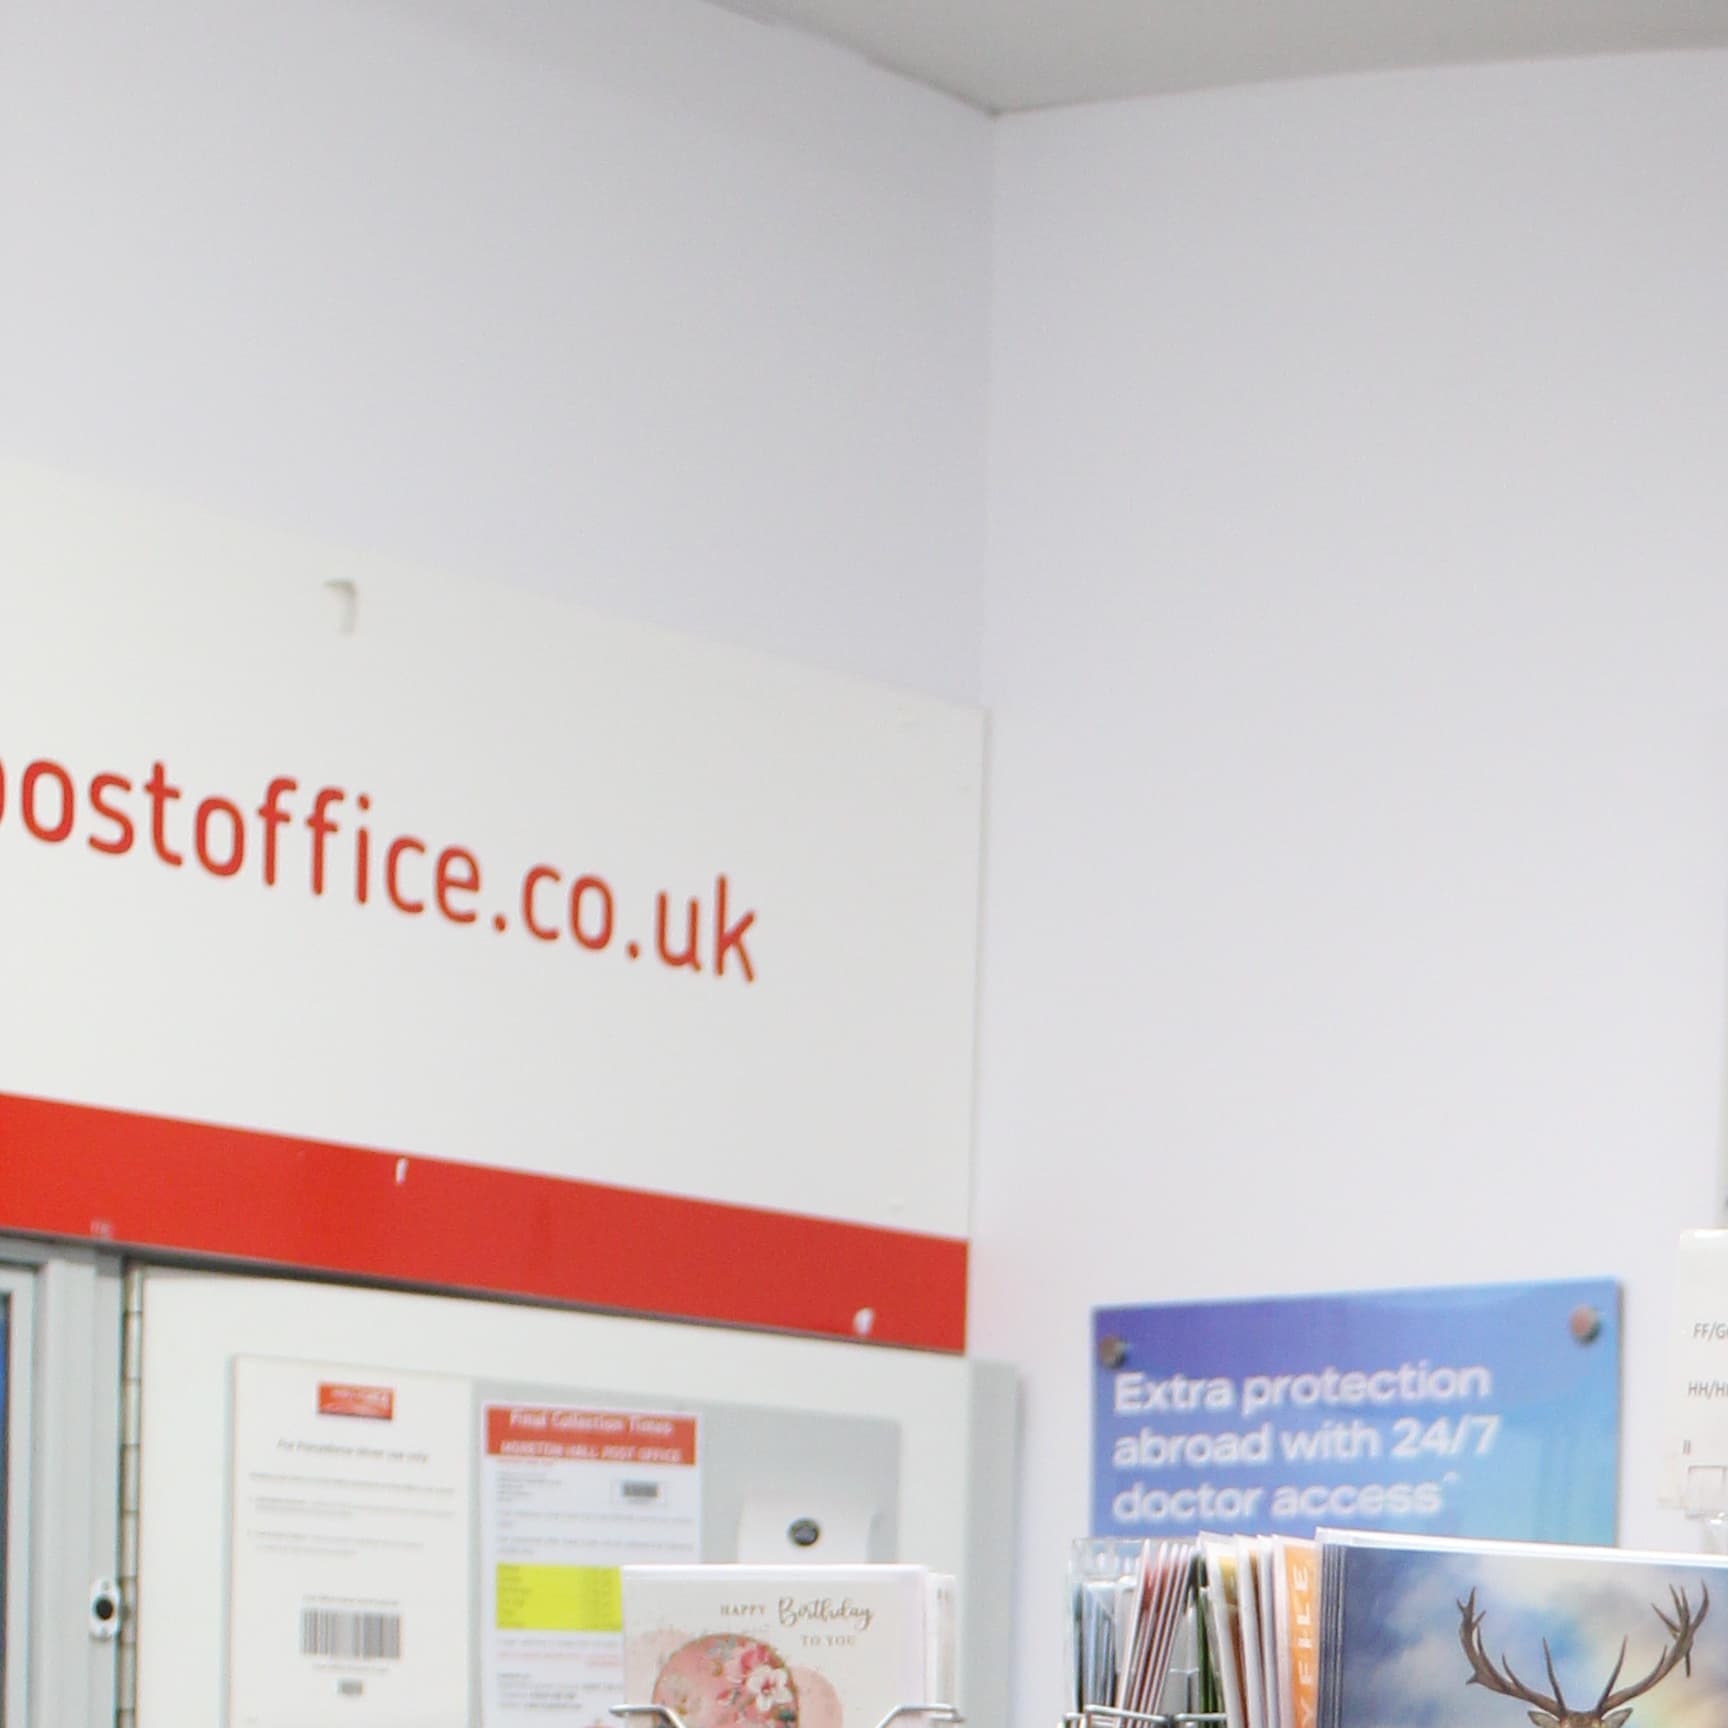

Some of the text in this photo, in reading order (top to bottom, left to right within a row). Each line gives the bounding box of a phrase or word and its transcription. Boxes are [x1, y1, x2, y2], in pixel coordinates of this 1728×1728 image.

[0, 757, 757, 983] ostoffice.co.uk
[1114, 1358, 1491, 1417] Extra protection
[1112, 1413, 1502, 1469] abroad with 24/7
[1114, 1484, 1259, 1525] doctor
[720, 1597, 874, 1631] HAPPY Birthday
